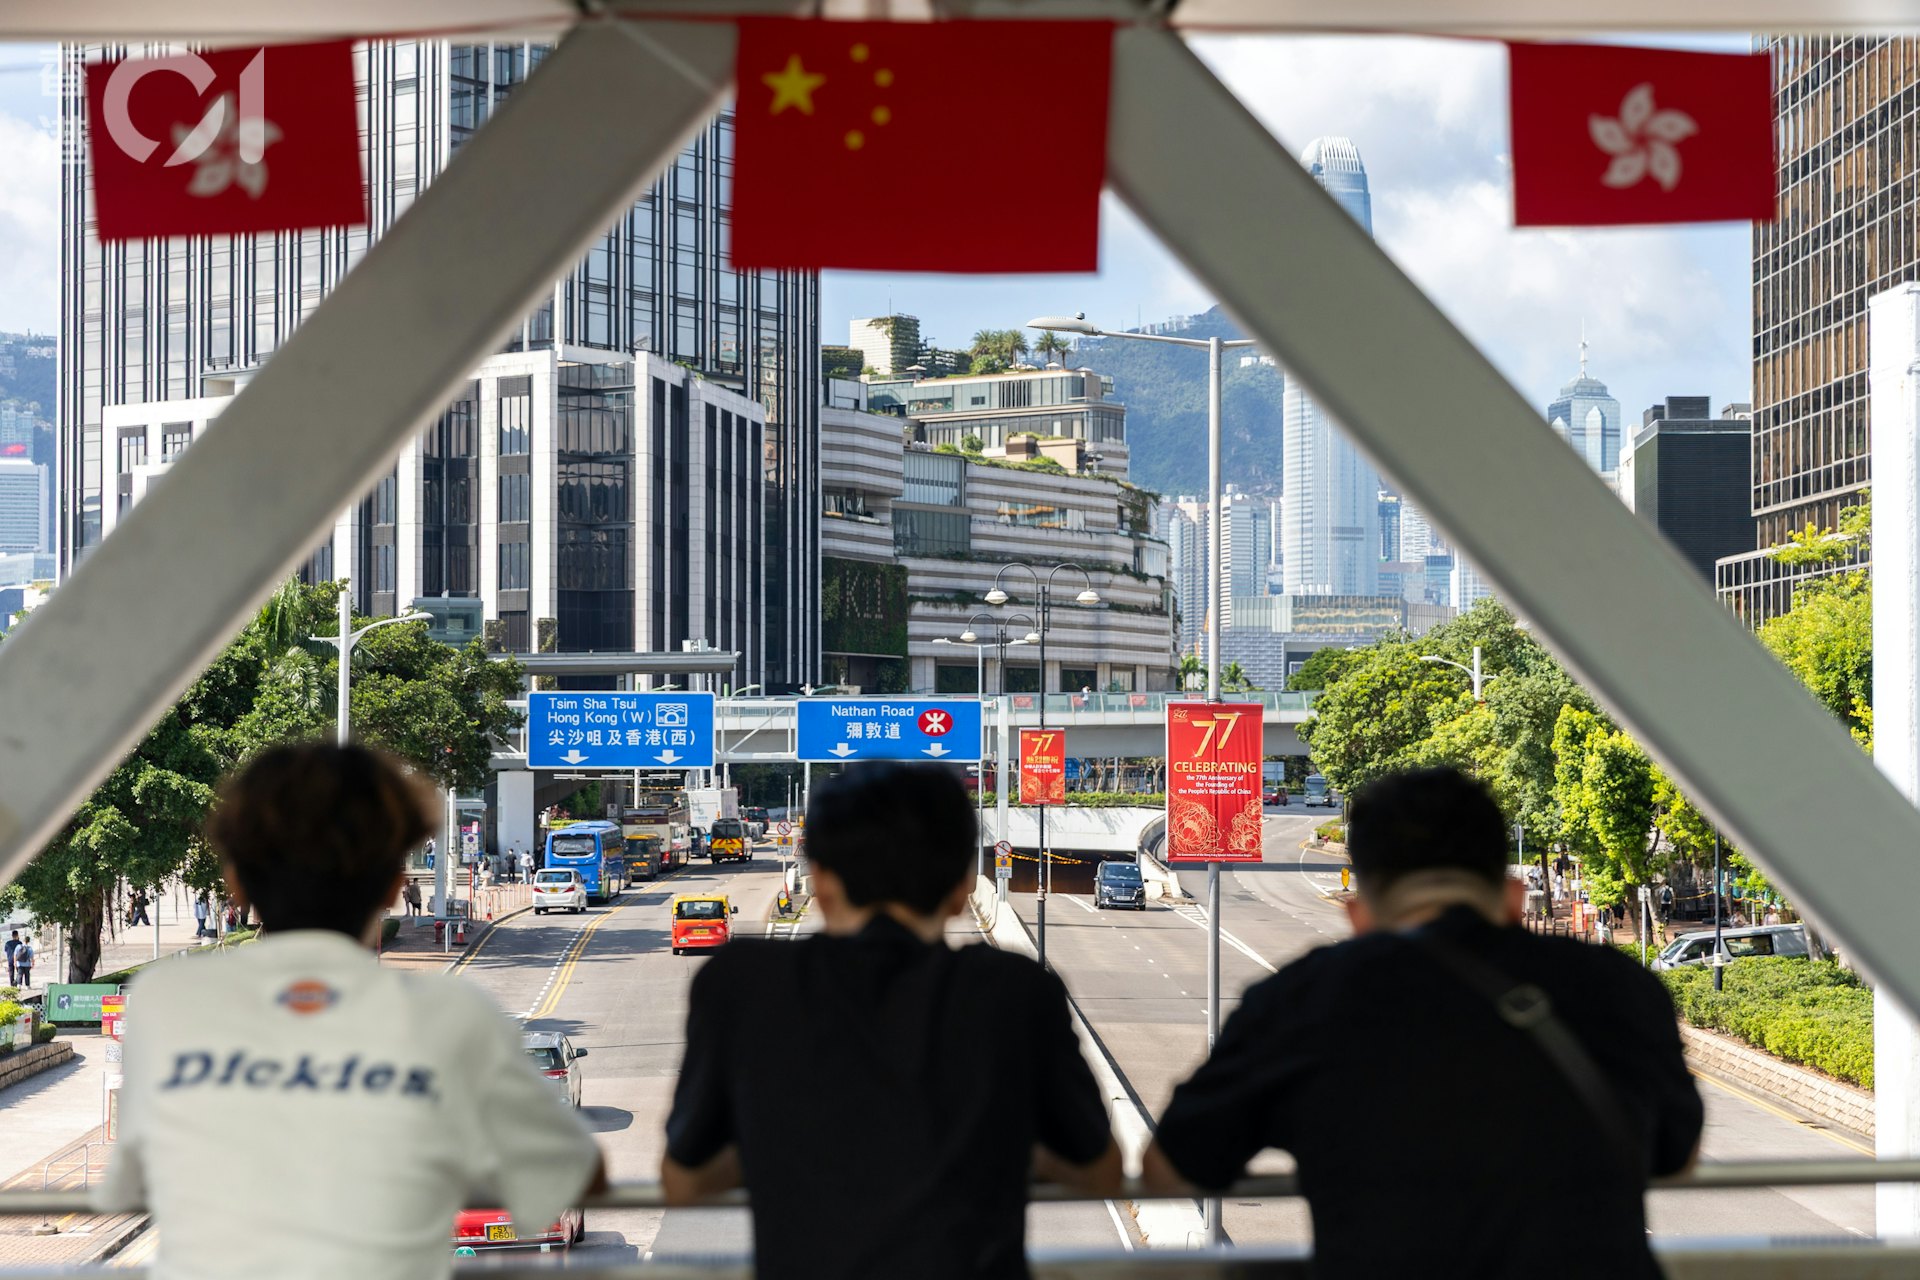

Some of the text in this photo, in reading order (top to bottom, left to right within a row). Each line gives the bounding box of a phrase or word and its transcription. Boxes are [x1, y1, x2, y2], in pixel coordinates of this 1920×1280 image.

[548, 697, 637, 710] Tsim Sha Tsui
[831, 704, 914, 717] Nathan Road
[547, 711, 580, 726] Hong
[585, 711, 618, 726] Kong
[548, 728, 696, 746] 尖沙咀及香港(西)
[846, 721, 901, 739] 彌敦道
[1192, 712, 1242, 757] 77
[1031, 733, 1055, 756] 77
[1173, 761, 1257, 773] CELEBRATING
[160, 1045, 438, 1099] Dickies
[493, 1232, 513, 1240] 6601
[497, 1225, 509, 1233] SX
